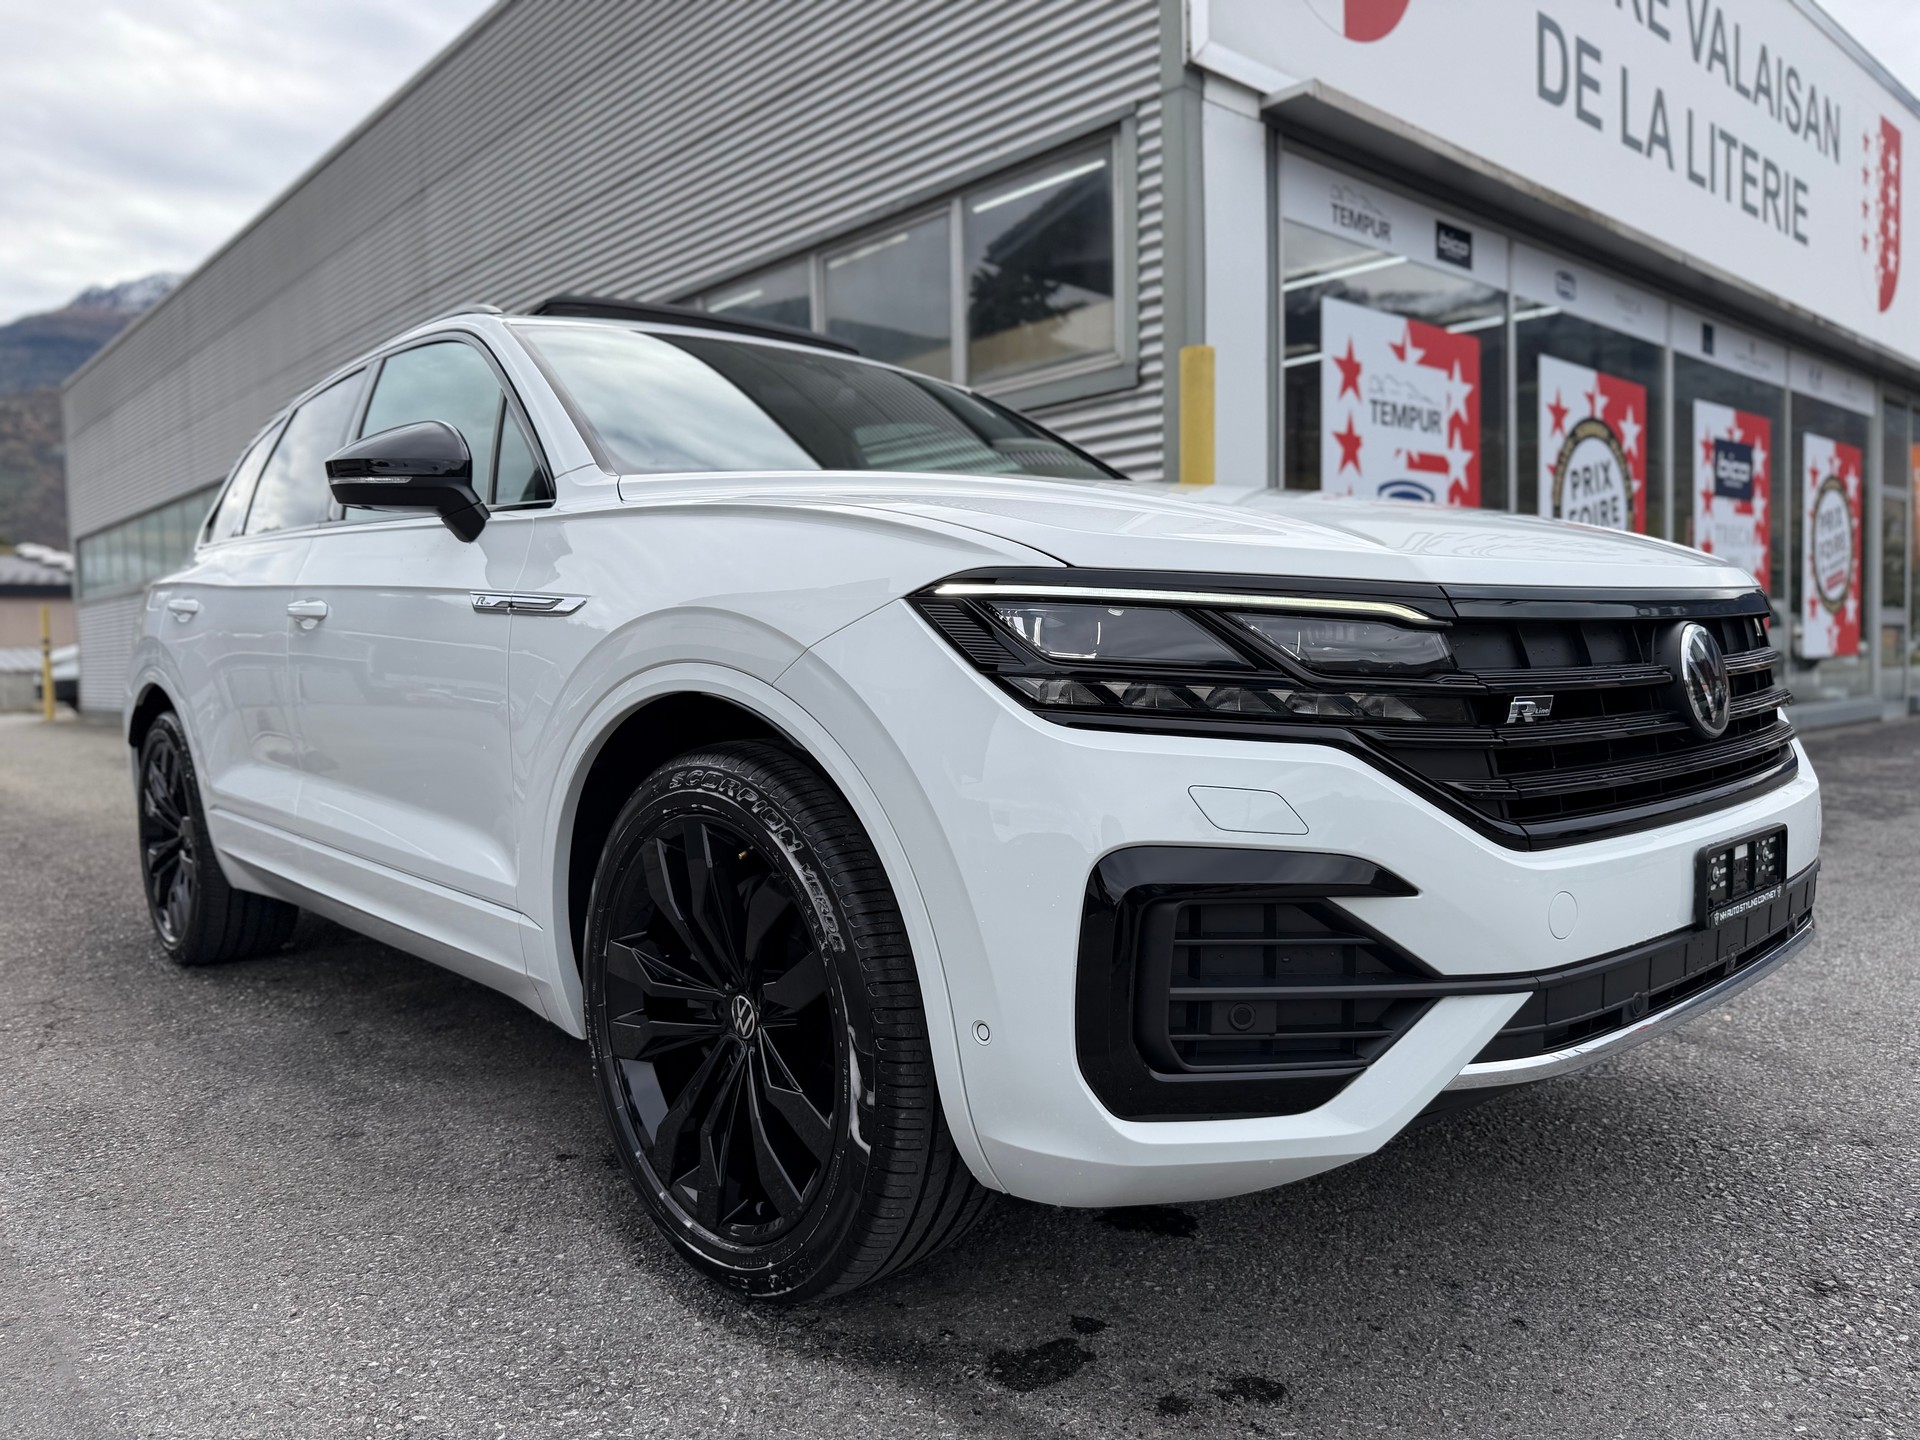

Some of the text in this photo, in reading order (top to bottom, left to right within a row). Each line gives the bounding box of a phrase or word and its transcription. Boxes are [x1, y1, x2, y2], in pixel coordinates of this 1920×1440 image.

[1686, 0, 1841, 165] VALAISAN
[1537, 10, 1808, 247] DE LA LITERIE
[1330, 203, 1392, 243] TEMPUR
[1369, 398, 1442, 434] TEMPUR
[1570, 459, 1613, 501] PRIX
[669, 769, 805, 854] SCORPION
